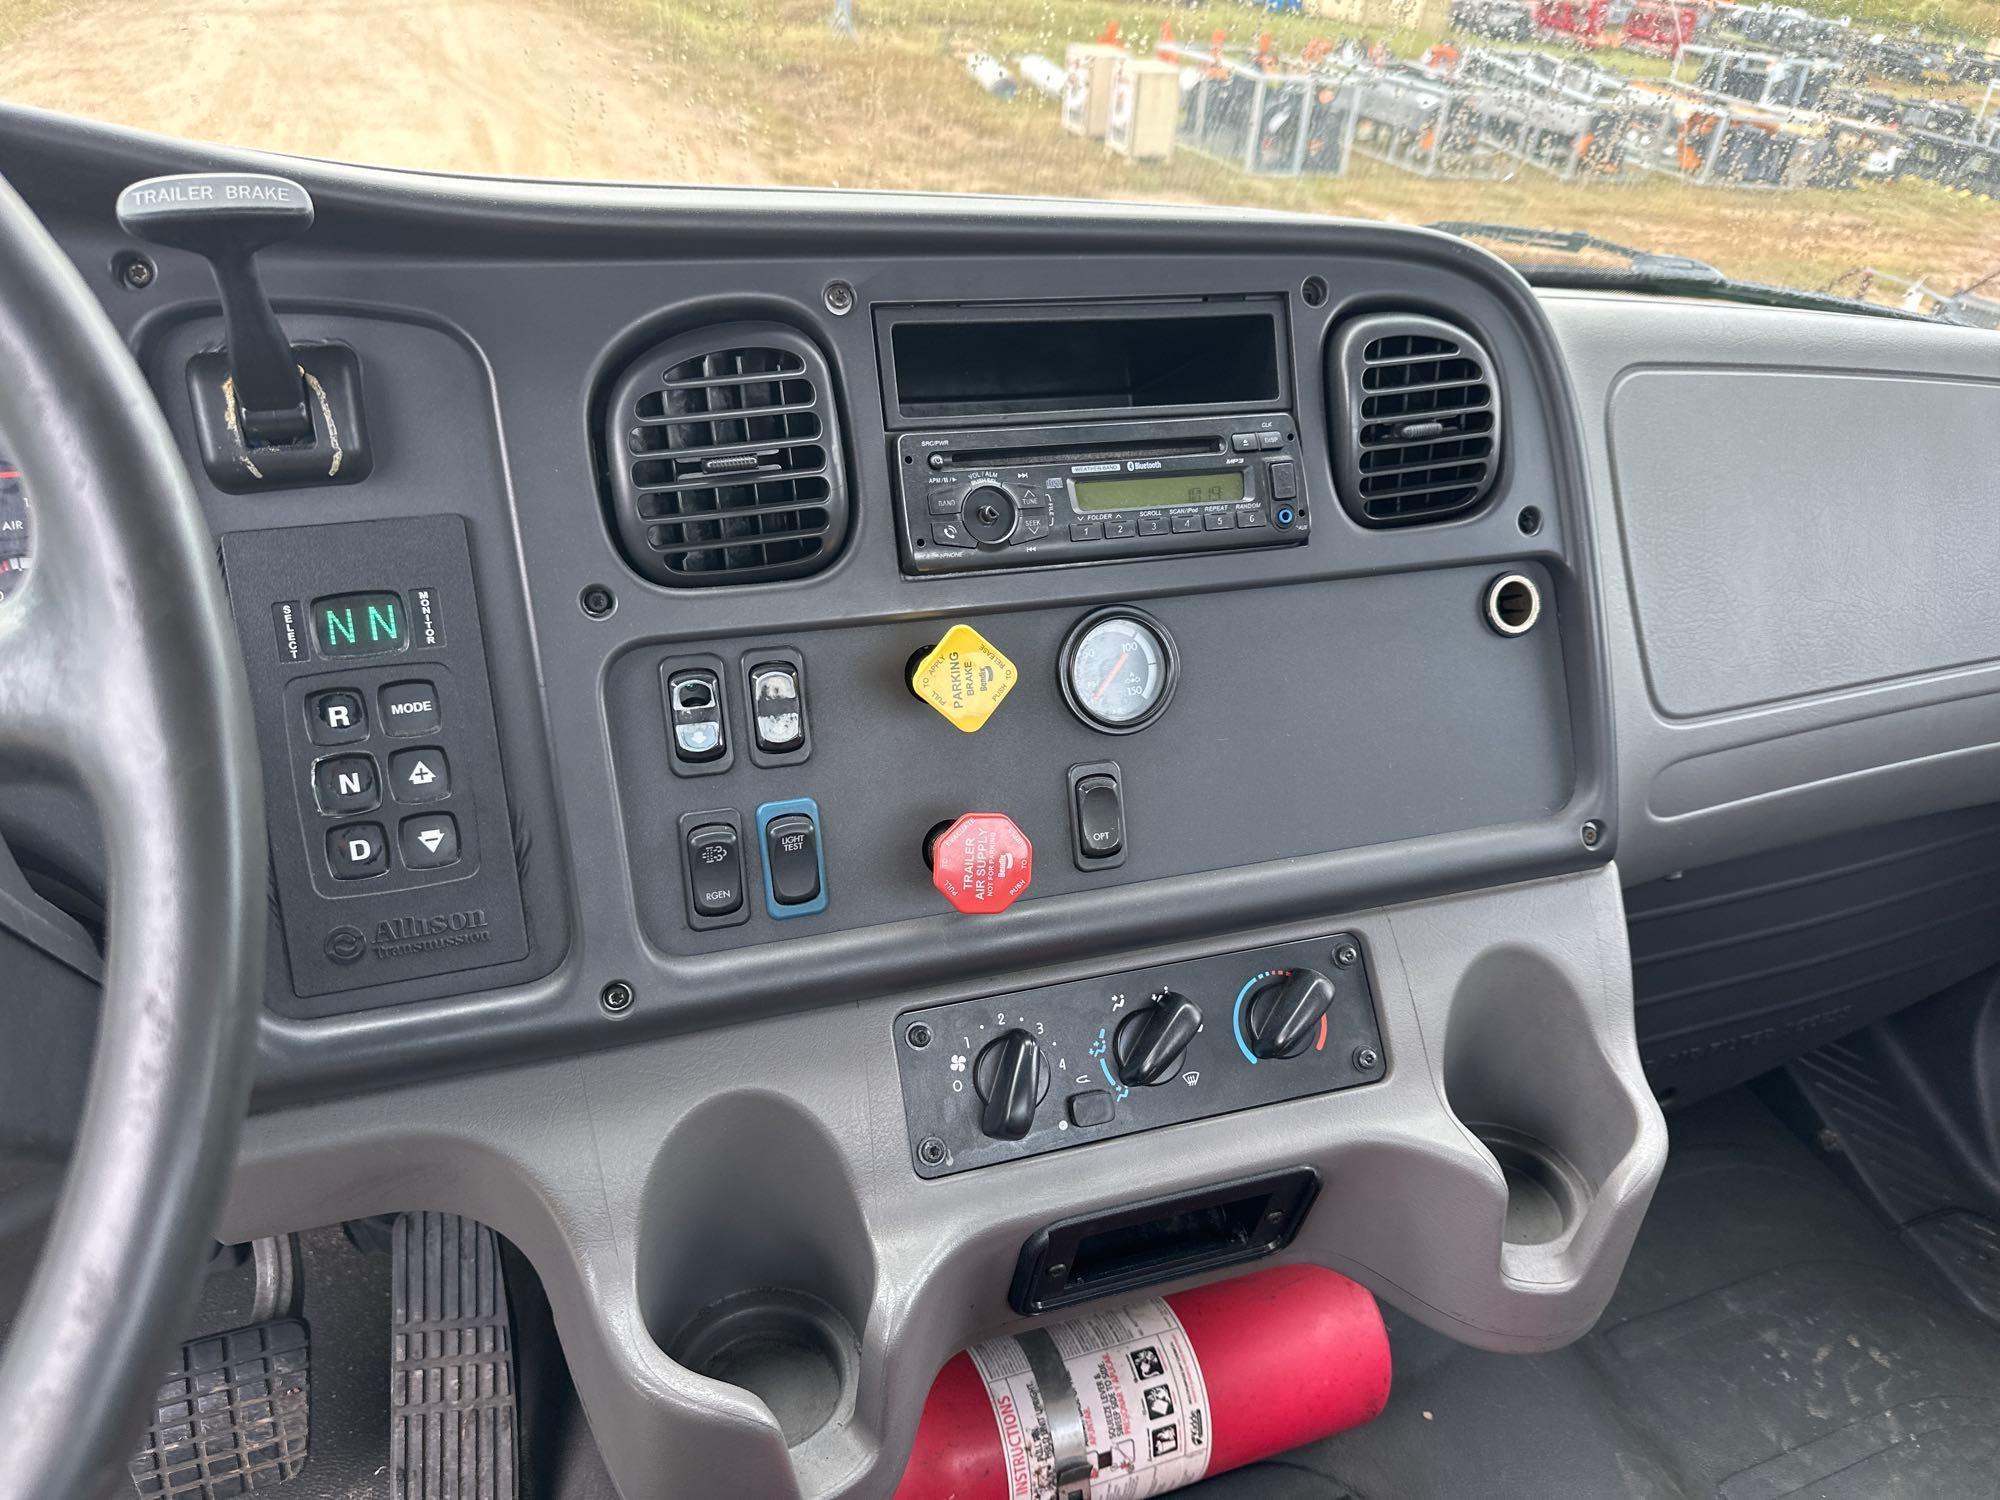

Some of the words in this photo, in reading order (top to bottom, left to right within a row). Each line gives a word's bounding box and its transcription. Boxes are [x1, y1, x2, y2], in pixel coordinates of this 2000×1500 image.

[132, 185, 213, 206] TRAILER
[226, 185, 290, 202] BRAKE
[1134, 461, 1162, 470] Bluetooth
[1169, 507, 1199, 515] SCAN/iPod
[2, 520, 24, 531] AIR
[1118, 525, 1123, 533] 2
[1151, 522, 1157, 531] 3
[1184, 519, 1191, 528] 4
[1217, 517, 1223, 525] 5
[326, 608, 356, 645] N
[368, 604, 398, 641] N
[418, 591, 436, 645] MONITOR
[282, 604, 298, 659] SELECT
[1121, 641, 1138, 653] 100
[979, 643, 1006, 669] RELEASE
[928, 655, 946, 676] APPLY
[922, 677, 930, 688] TO
[949, 651, 964, 709] PARKING
[964, 661, 975, 697] BRAKE
[1005, 669, 1012, 680] TO
[931, 690, 946, 706] PULL
[991, 683, 1008, 702] PUSH
[1126, 685, 1143, 697] 150
[391, 700, 433, 715] MODE
[328, 705, 350, 728] R
[338, 772, 361, 795] N
[781, 834, 805, 845] LIGHT
[1093, 831, 1110, 841] OPT
[349, 839, 371, 862] D
[784, 842, 804, 852] TEST
[976, 828, 988, 877] SUPPLY
[988, 832, 997, 864] PARKING
[963, 837, 975, 890] TRAILER
[987, 864, 995, 881] FOR
[1008, 879, 1026, 896] PUSH
[1021, 859, 1028, 870] TO
[705, 889, 731, 901] RGEN
[943, 880, 959, 897] PULL
[975, 880, 986, 901] AIR
[370, 908, 489, 944] Allison
[997, 1012, 1006, 1026] 2
[1036, 1022, 1044, 1035] 3
[963, 1036, 970, 1049] 1
[1058, 1058, 1067, 1071] 4
[1096, 1380, 1109, 1405] LEVER
[1104, 1380, 1113, 1391] TO
[1108, 1391, 1119, 1410] SIDE
[1103, 1405, 1117, 1440] SQUEEZE
[1113, 1410, 1124, 1438] SWEEP
[997, 1394, 1029, 1497] INSTRUCTIONS
